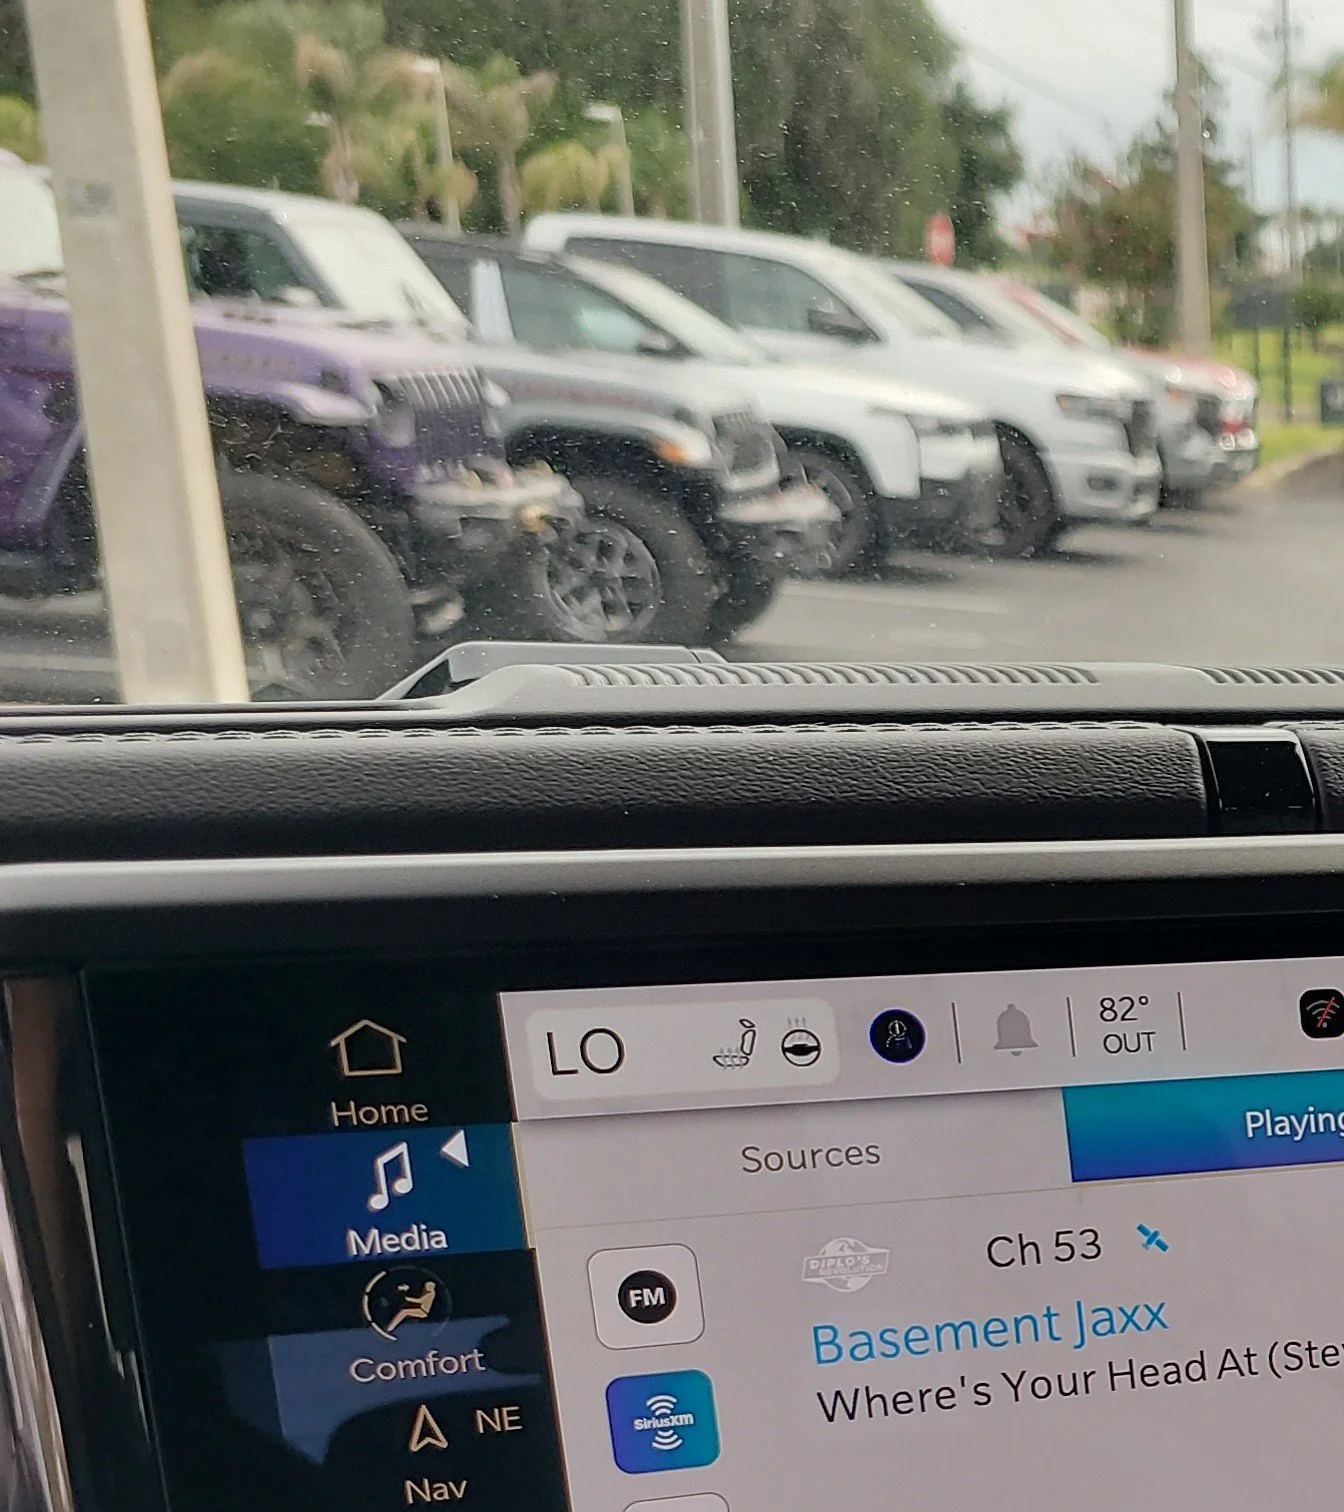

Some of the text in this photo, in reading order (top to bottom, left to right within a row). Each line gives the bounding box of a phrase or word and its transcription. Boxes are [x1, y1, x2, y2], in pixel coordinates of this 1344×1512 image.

[1099, 996, 1150, 1023] 82°
[547, 1028, 626, 1076] LO
[1103, 1031, 1157, 1054] OUT
[330, 1099, 430, 1128] Home
[741, 1140, 882, 1174] Sources
[346, 1223, 449, 1258] Media
[986, 1228, 1103, 1269] Ch 53
[628, 1284, 667, 1309] FM
[811, 1299, 1171, 1365] Basement Jaxx
[349, 1347, 488, 1383] Comfort
[817, 1375, 993, 1423] Where's
[1001, 1366, 1097, 1403] Your
[1109, 1352, 1208, 1392] Head
[1216, 1346, 1260, 1381] At
[474, 1406, 524, 1434] NE
[403, 1478, 468, 1506] Nav
